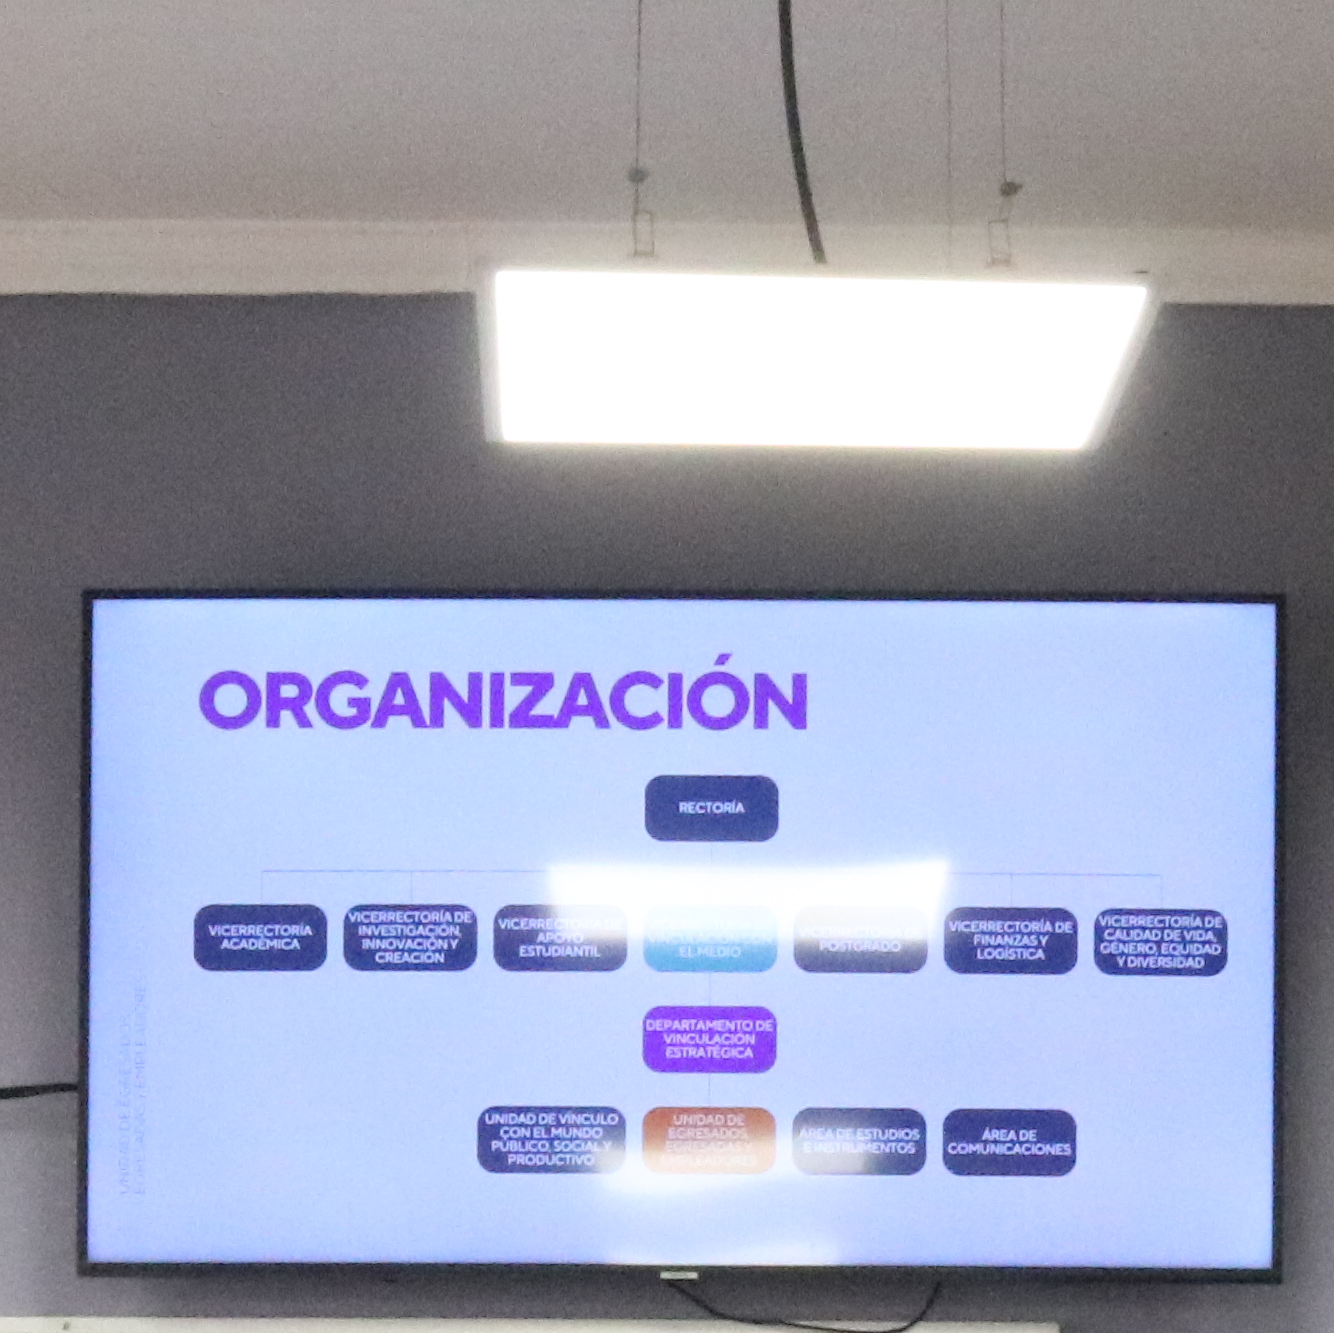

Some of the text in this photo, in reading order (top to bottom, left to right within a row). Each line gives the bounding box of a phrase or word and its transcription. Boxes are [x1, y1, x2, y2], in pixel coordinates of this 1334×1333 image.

[199, 653, 808, 731] ORGANIZACIÓN
[679, 799, 746, 815] RECTORÍA
[348, 910, 473, 923] VICERRECTORÍA DE
[1098, 914, 1223, 928] VICERRECTORÍA DE
[208, 923, 313, 937] VICERRECTORÍA
[948, 919, 1074, 934] VICERRECTORÍA DE
[220, 936, 302, 950] ACADÉMICA
[536, 932, 584, 944] APOYO
[973, 934, 1049, 947] FINANZAS Y
[1103, 929, 1217, 943] CALIDAD DE VIDA,
[362, 937, 459, 950] INNOVACIÓN Y
[1161, 943, 1222, 956] EQUIDAD
[375, 950, 445, 964] CREACIÓN
[519, 945, 601, 958] ESTUDIANTIL
[976, 947, 1046, 960] LOGÍSTICA
[1117, 956, 1206, 969] Y DIVERSIDAD
[645, 1018, 774, 1032] DEPARTAMENTO DE
[663, 1031, 756, 1045] VINCULACIÓN
[665, 1045, 754, 1059] ESTRATÉGICA
[485, 1113, 536, 1125] UNIDAD
[538, 1113, 557, 1125] DE
[673, 1113, 745, 1125] UNIDAD DE
[500, 1126, 603, 1140] CON EL MUNDO
[856, 1128, 920, 1140] ESTUDIOS
[981, 1126, 1037, 1141] ÁREA DE
[552, 1140, 602, 1152] SOCIAL
[947, 1142, 1072, 1156] COMUNICACIONES
[508, 1153, 594, 1166] PRODUCTIVO
